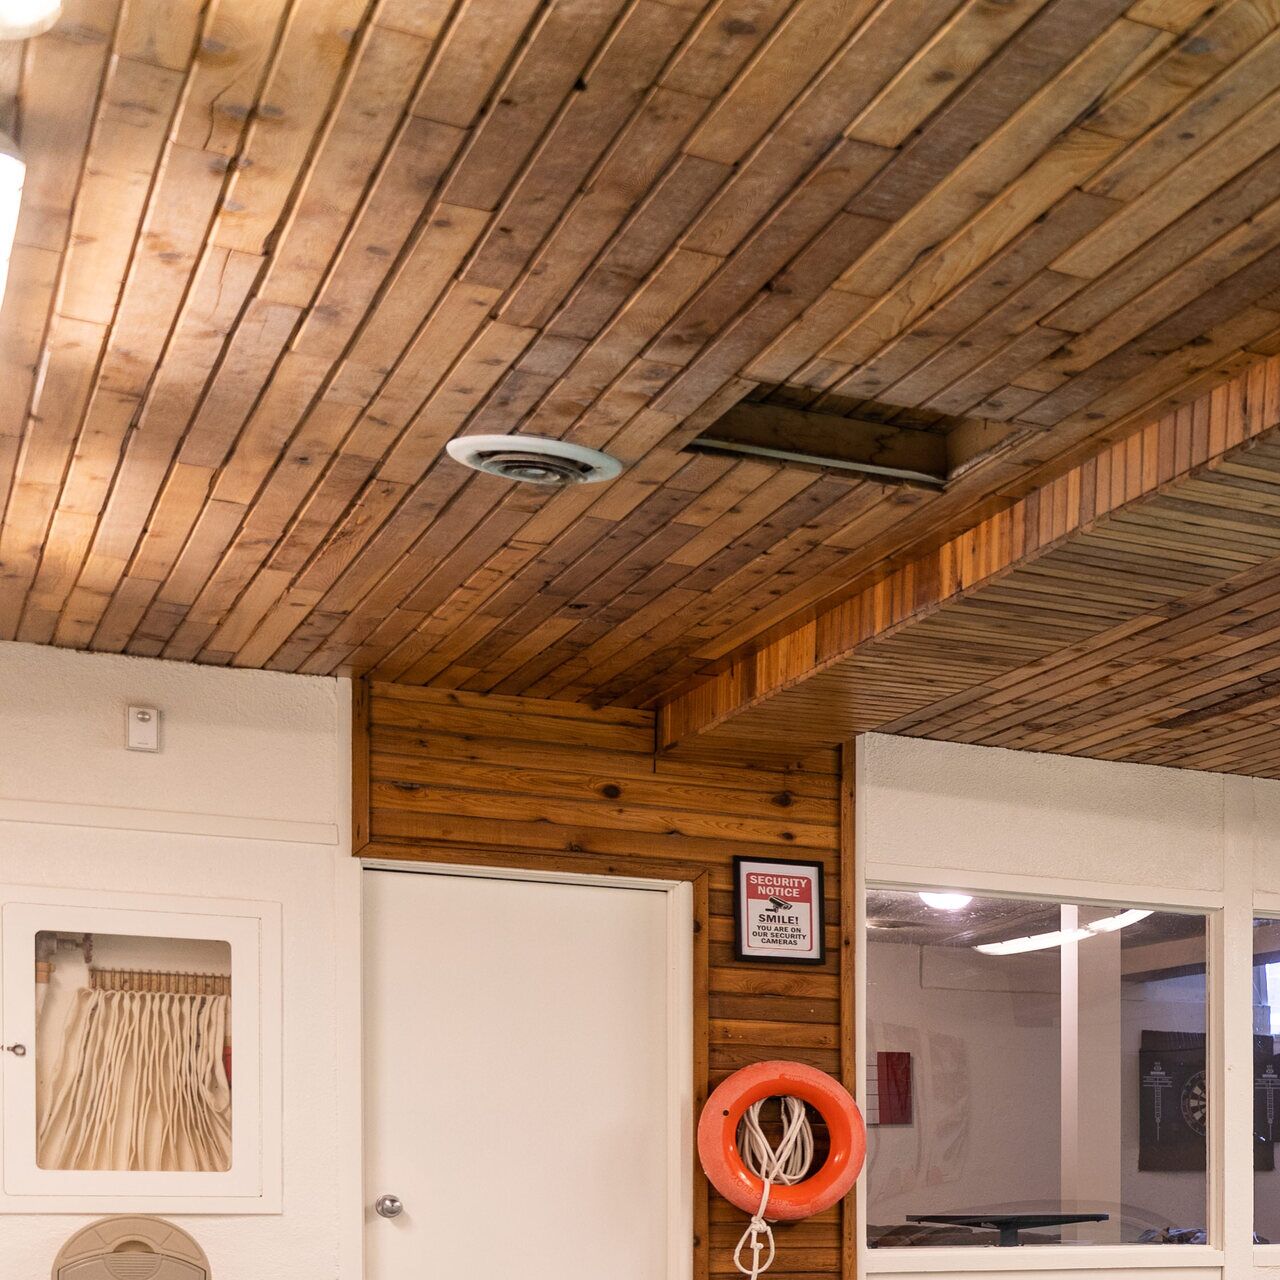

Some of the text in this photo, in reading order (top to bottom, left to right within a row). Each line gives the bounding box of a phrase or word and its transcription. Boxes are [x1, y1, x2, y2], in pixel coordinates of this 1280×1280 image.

[750, 875, 808, 888] SECURITY
[757, 886, 800, 898] NOTICE
[758, 913, 799, 925] SMILE!
[756, 924, 772, 932] YOU
[790, 926, 802, 934] ON
[752, 930, 807, 940] OUR SECURITY
[760, 937, 798, 946] CAMERAS
